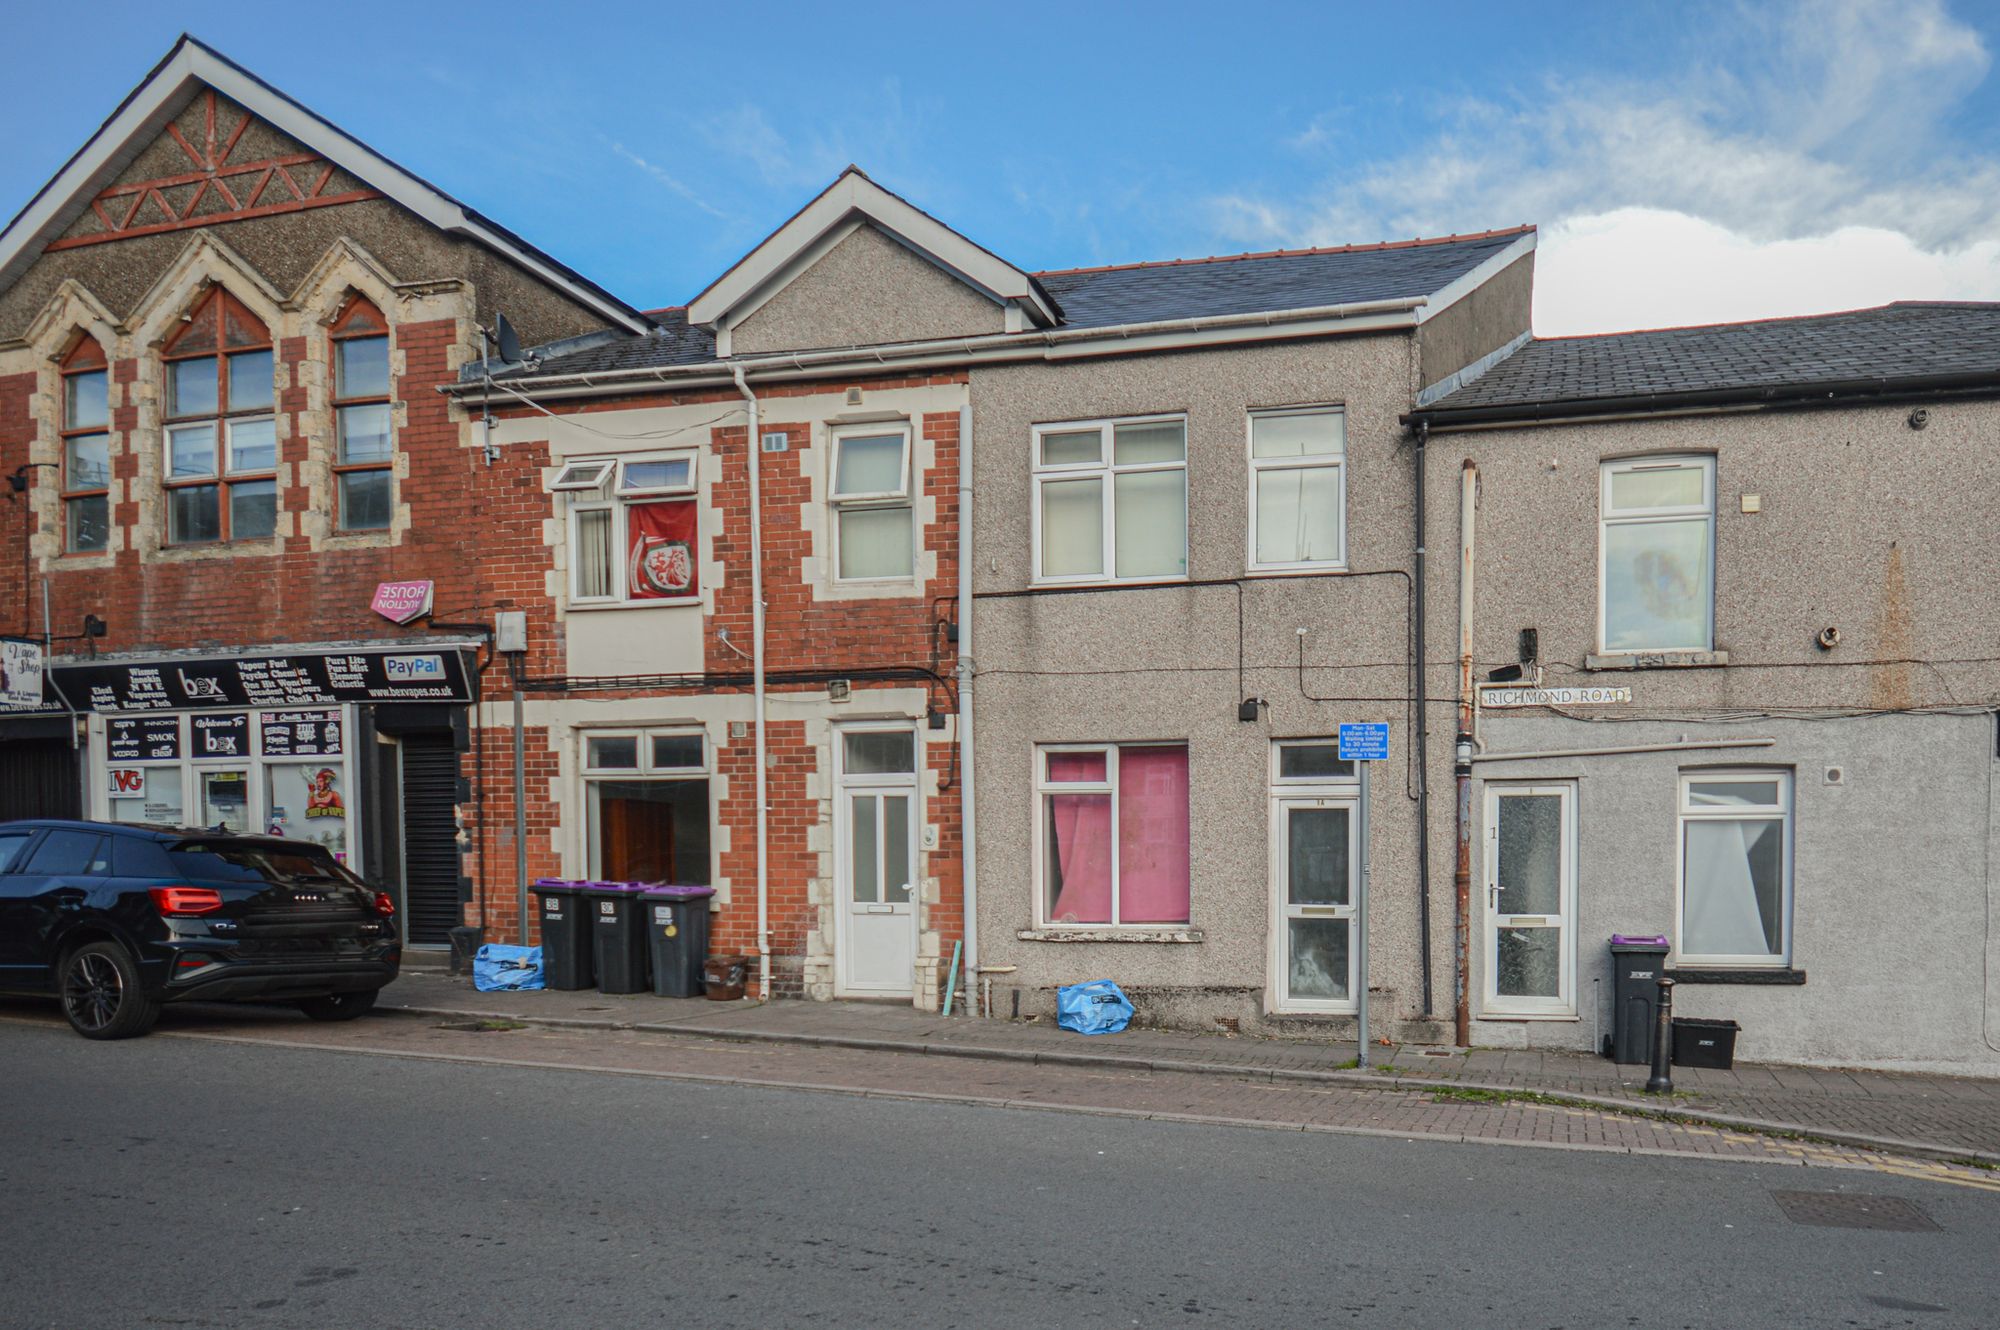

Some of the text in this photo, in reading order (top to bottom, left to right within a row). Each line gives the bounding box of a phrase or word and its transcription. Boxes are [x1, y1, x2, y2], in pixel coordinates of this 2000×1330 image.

[236, 659, 288, 670] Vapour Fuel
[324, 655, 366, 665] Pura Lite
[326, 664, 369, 673] Pure Mist
[388, 658, 438, 677] PayPal
[239, 671, 269, 680] Psycho
[328, 672, 363, 680] Element
[242, 681, 260, 690] One
[261, 679, 276, 688] Hit
[331, 679, 366, 689] Galactic
[368, 686, 453, 699] www.bexvapes.co.uk
[1488, 689, 1625, 704] RICHMOND ROAD
[285, 694, 314, 704] Chalk
[314, 693, 337, 702] Dust
[195, 716, 247, 729] Welcome To
[147, 732, 177, 742] SMOK
[109, 770, 143, 792] IVG
[1490, 826, 1497, 840] 1
